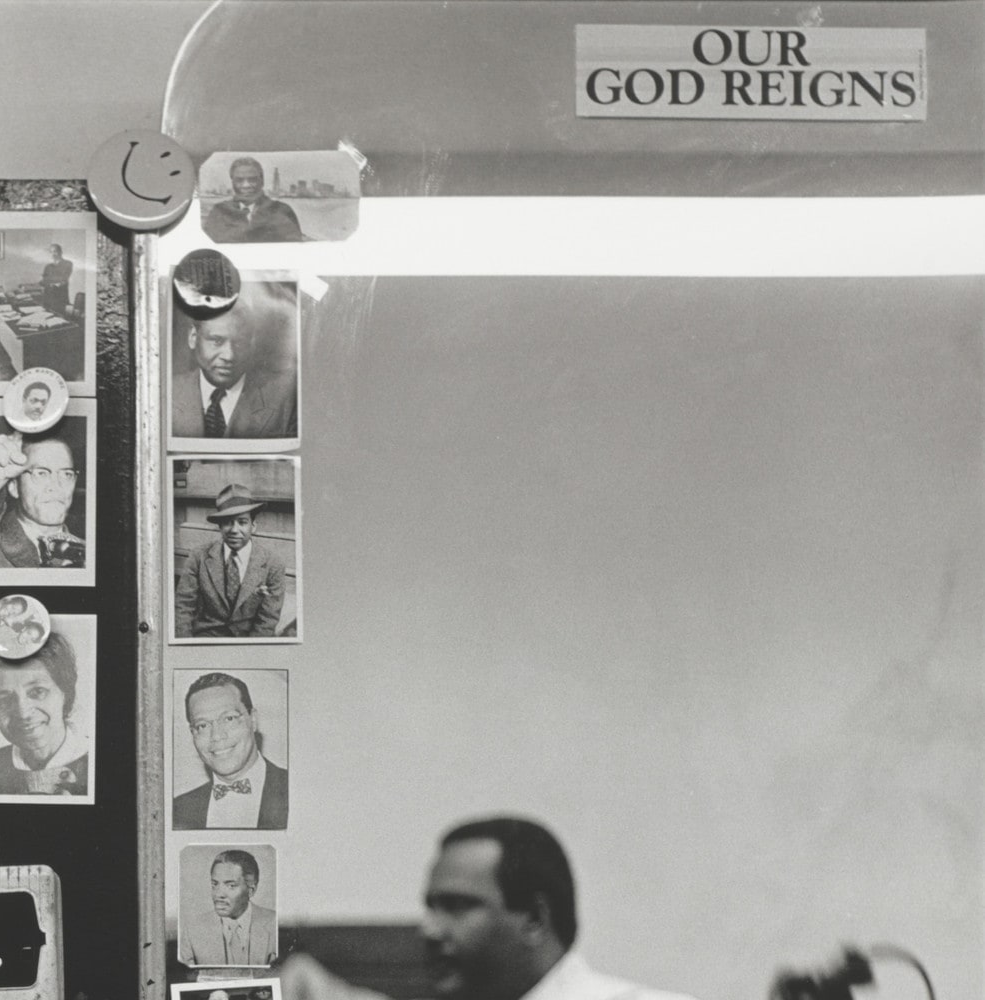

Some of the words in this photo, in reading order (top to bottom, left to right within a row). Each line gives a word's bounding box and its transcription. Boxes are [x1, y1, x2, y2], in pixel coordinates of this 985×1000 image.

[692, 29, 811, 67] OUR
[585, 67, 705, 105] GOD
[720, 70, 917, 108] REIGNS
